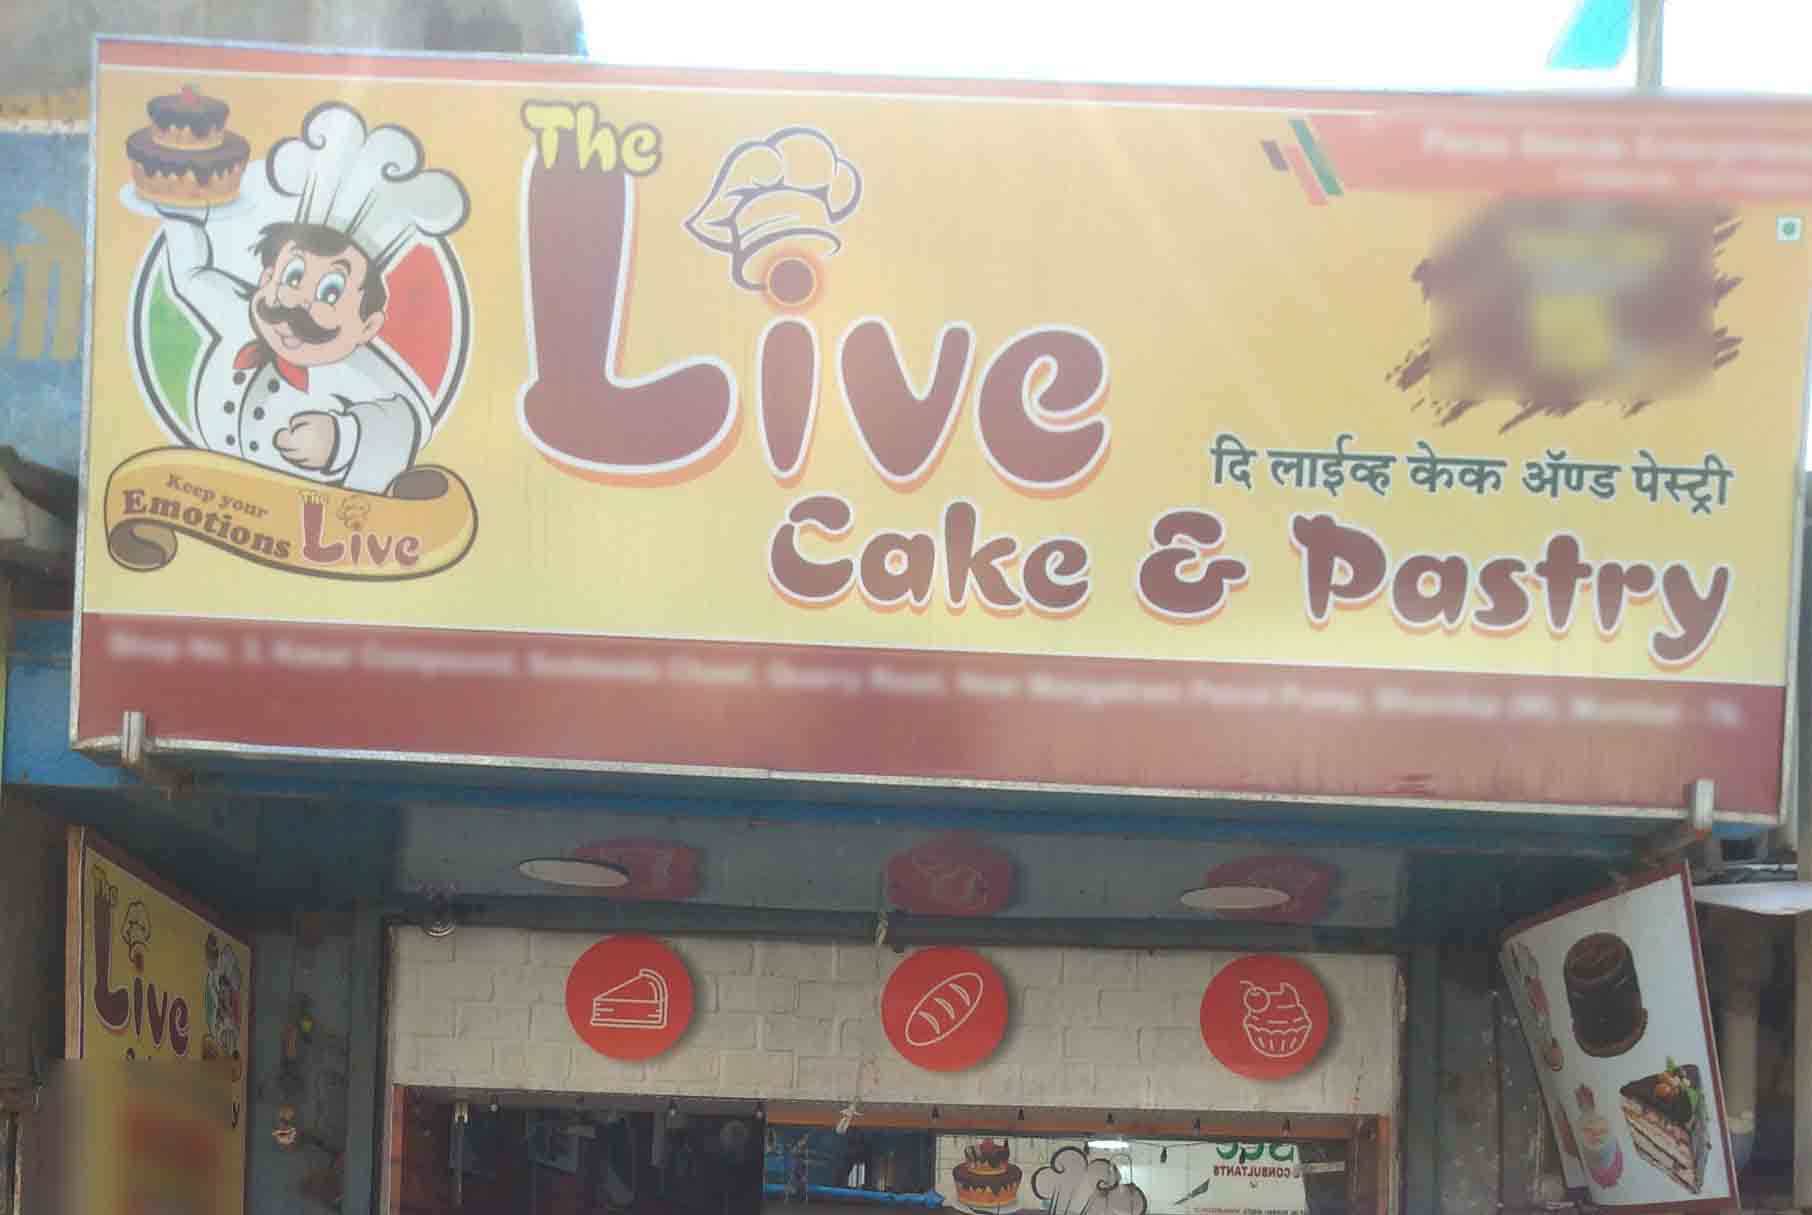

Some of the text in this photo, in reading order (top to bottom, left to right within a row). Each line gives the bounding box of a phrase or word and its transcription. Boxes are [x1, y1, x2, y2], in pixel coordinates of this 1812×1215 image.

[521, 100, 662, 176] The
[519, 135, 1110, 495] Live
[166, 472, 269, 520] Keep your
[1210, 433, 1258, 490] दि
[1266, 433, 1398, 497] लाईव्ह
[1406, 440, 1508, 494] केक
[1632, 449, 1735, 514] पेस्ट्री
[122, 488, 421, 568] Emotions Live
[769, 494, 1731, 666] Cake & Pastry
[93, 885, 190, 1057] Live
